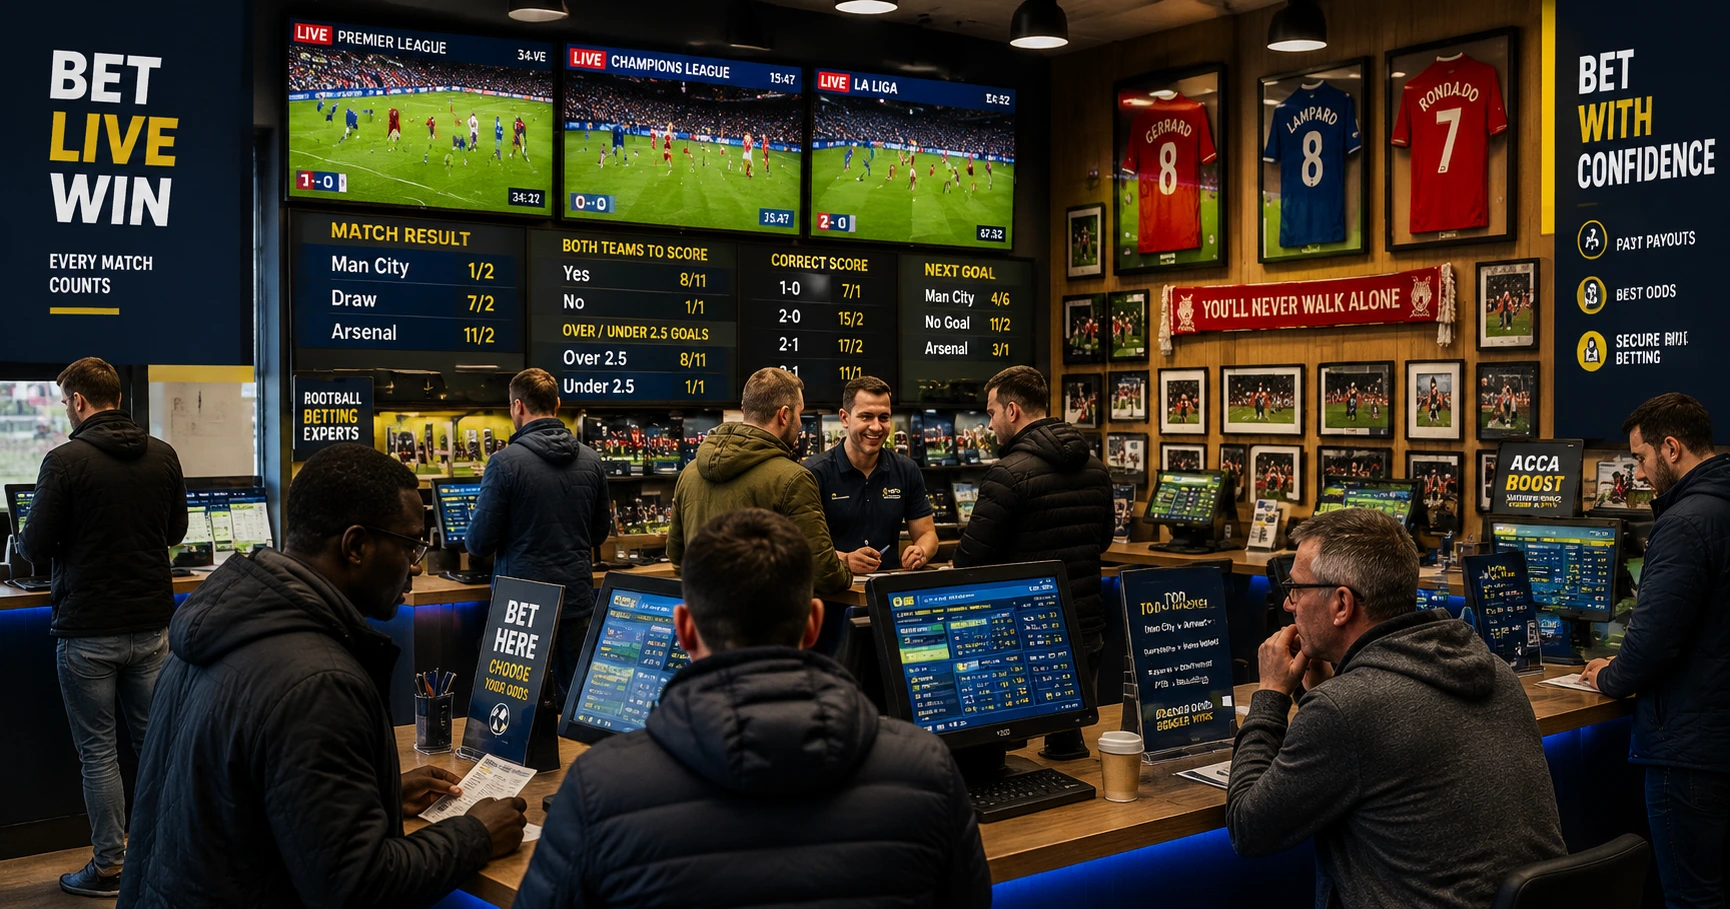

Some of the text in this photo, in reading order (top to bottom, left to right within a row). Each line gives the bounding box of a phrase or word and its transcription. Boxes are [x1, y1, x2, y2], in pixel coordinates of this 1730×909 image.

[298, 26, 327, 41] LIVE
[339, 31, 446, 54] PREMIER LEAGUE
[574, 52, 601, 66] LIVE
[612, 55, 729, 78] CHAMPIONS LEAGUE
[50, 50, 162, 104] BET
[1579, 49, 1634, 94] BET
[821, 75, 846, 89] LIVE
[855, 78, 897, 94] LA LIGA
[1577, 96, 1653, 144] WITH
[50, 112, 178, 166] LIVE
[1145, 118, 1192, 144] GERRARD
[1437, 108, 1461, 173] 7
[1302, 131, 1323, 187] 8
[1577, 138, 1716, 189] CONFIDENCE
[1159, 142, 1177, 195] 8
[51, 173, 171, 226] WIN
[332, 222, 470, 246] MATCH RESULT
[1647, 231, 1695, 248] PAYOUTS
[563, 239, 707, 260] BOTH TEAMS TO SCORE
[50, 254, 152, 270] EVERY MATCH
[332, 256, 409, 278] Man City
[772, 254, 868, 271] CORRECT SCORE
[469, 263, 493, 280] 1/2
[563, 266, 589, 281] Yes
[926, 263, 995, 279] NEXT GOAL
[50, 277, 110, 293] COUNTS
[680, 273, 705, 287] 8/11
[780, 281, 800, 295] 1-0
[332, 290, 376, 307] Draw
[842, 284, 860, 298] 7/1
[926, 289, 974, 307] Man City
[991, 292, 1009, 306] 4/6
[1617, 284, 1676, 301] BEST ODDS
[468, 295, 494, 312] 7/2
[564, 294, 584, 309] No
[686, 299, 703, 314] 1/1
[1203, 288, 1400, 318] YOU'LL NEVER WALK ALONE
[780, 309, 800, 323] 2-0
[839, 312, 863, 327] 15/2
[926, 315, 969, 329] No Goal
[332, 323, 396, 340] Arsenal
[563, 324, 595, 336] OVER
[608, 326, 647, 338] UNDER
[651, 327, 667, 339] 2.5
[671, 328, 708, 340] GOALS
[990, 317, 1010, 332] 11/2
[464, 327, 494, 344] 11/2
[1617, 333, 1660, 348] SECURE
[839, 339, 862, 353] 17/2
[925, 341, 967, 354] Arsenal
[993, 343, 1008, 356] 3/1
[564, 350, 626, 365] Over 2.5
[681, 352, 705, 368] 8/11
[1617, 350, 1660, 364] BETTING
[839, 366, 862, 380] 11/1
[564, 379, 634, 393] Under 2.5
[686, 380, 703, 394] 1/1
[304, 409, 357, 423] BETTING
[304, 427, 358, 440] EXPERTS
[1511, 455, 1559, 471] ACCA
[1506, 475, 1564, 491] BOOST
[505, 600, 539, 627] BET
[493, 627, 539, 660] HERE
